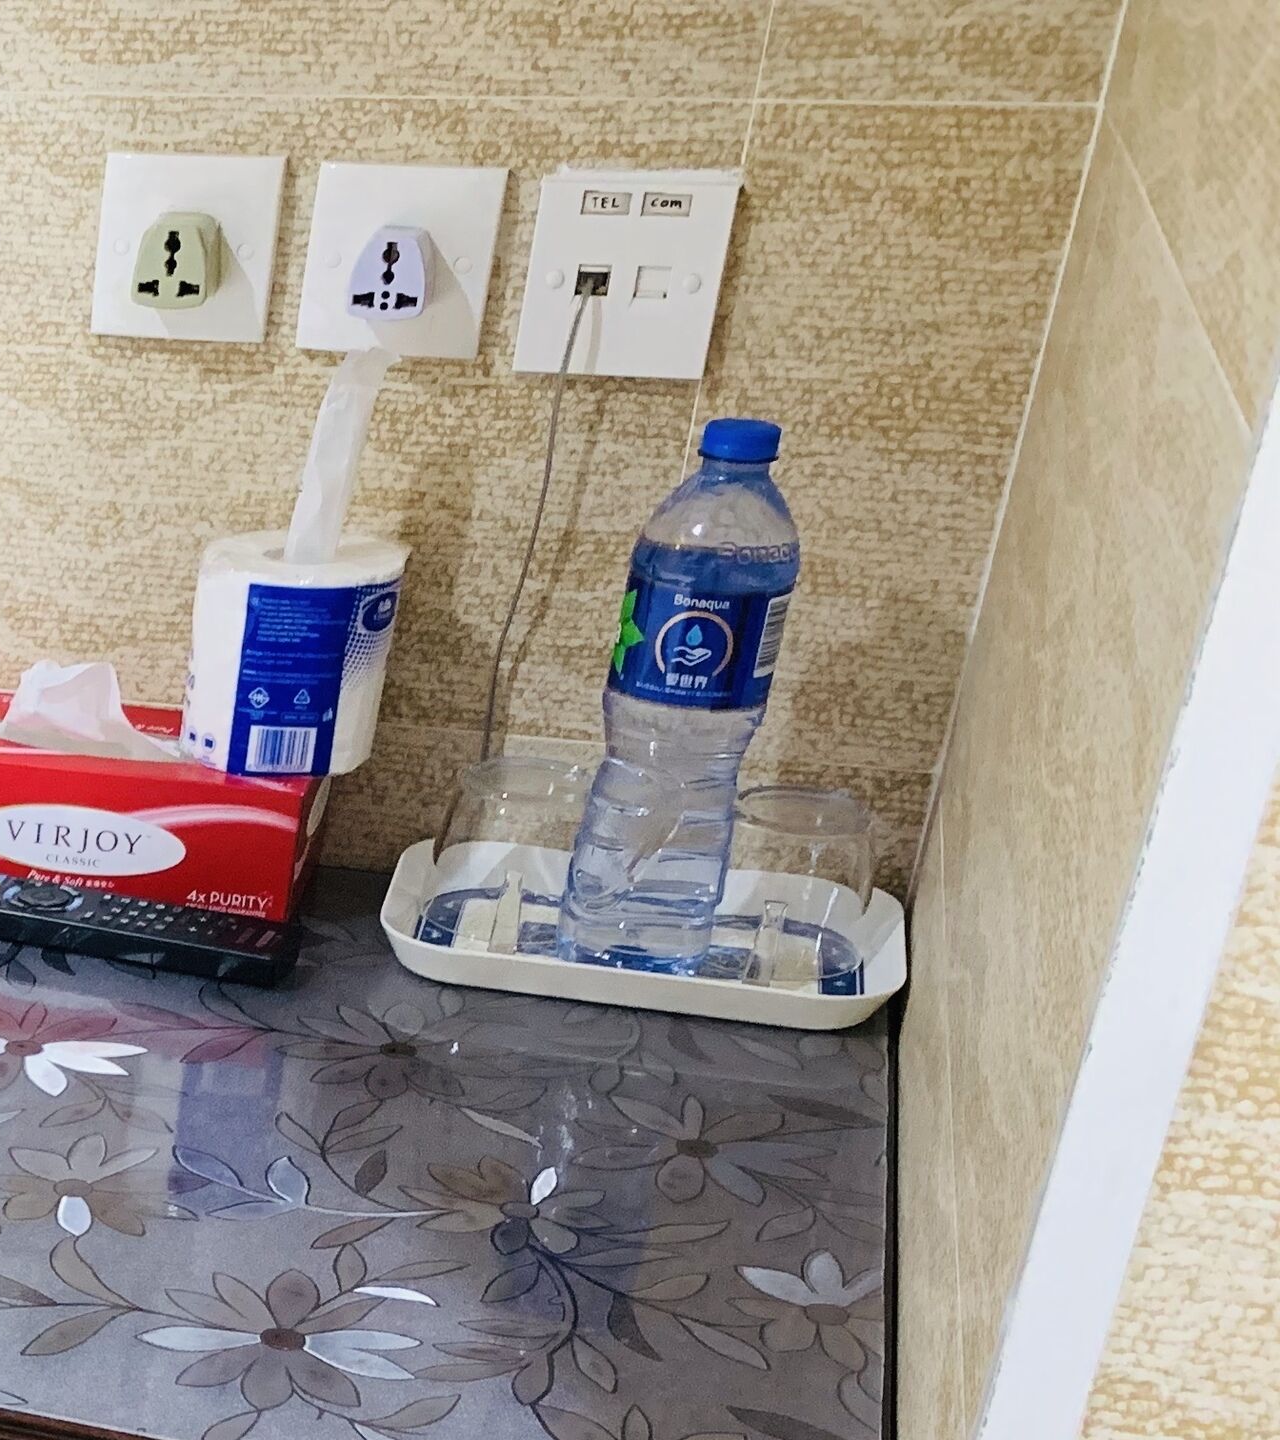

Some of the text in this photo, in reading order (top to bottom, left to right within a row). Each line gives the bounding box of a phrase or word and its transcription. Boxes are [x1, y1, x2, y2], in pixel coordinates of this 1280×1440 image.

[592, 197, 620, 208] TEL
[673, 593, 731, 611] Bonaqua
[6, 819, 143, 855] VIRJOY
[45, 853, 102, 868] CLASSIC
[27, 869, 50, 882] Pure
[62, 876, 84, 888] Soft
[186, 889, 207, 904] 4x
[209, 891, 269, 911] PURITY
